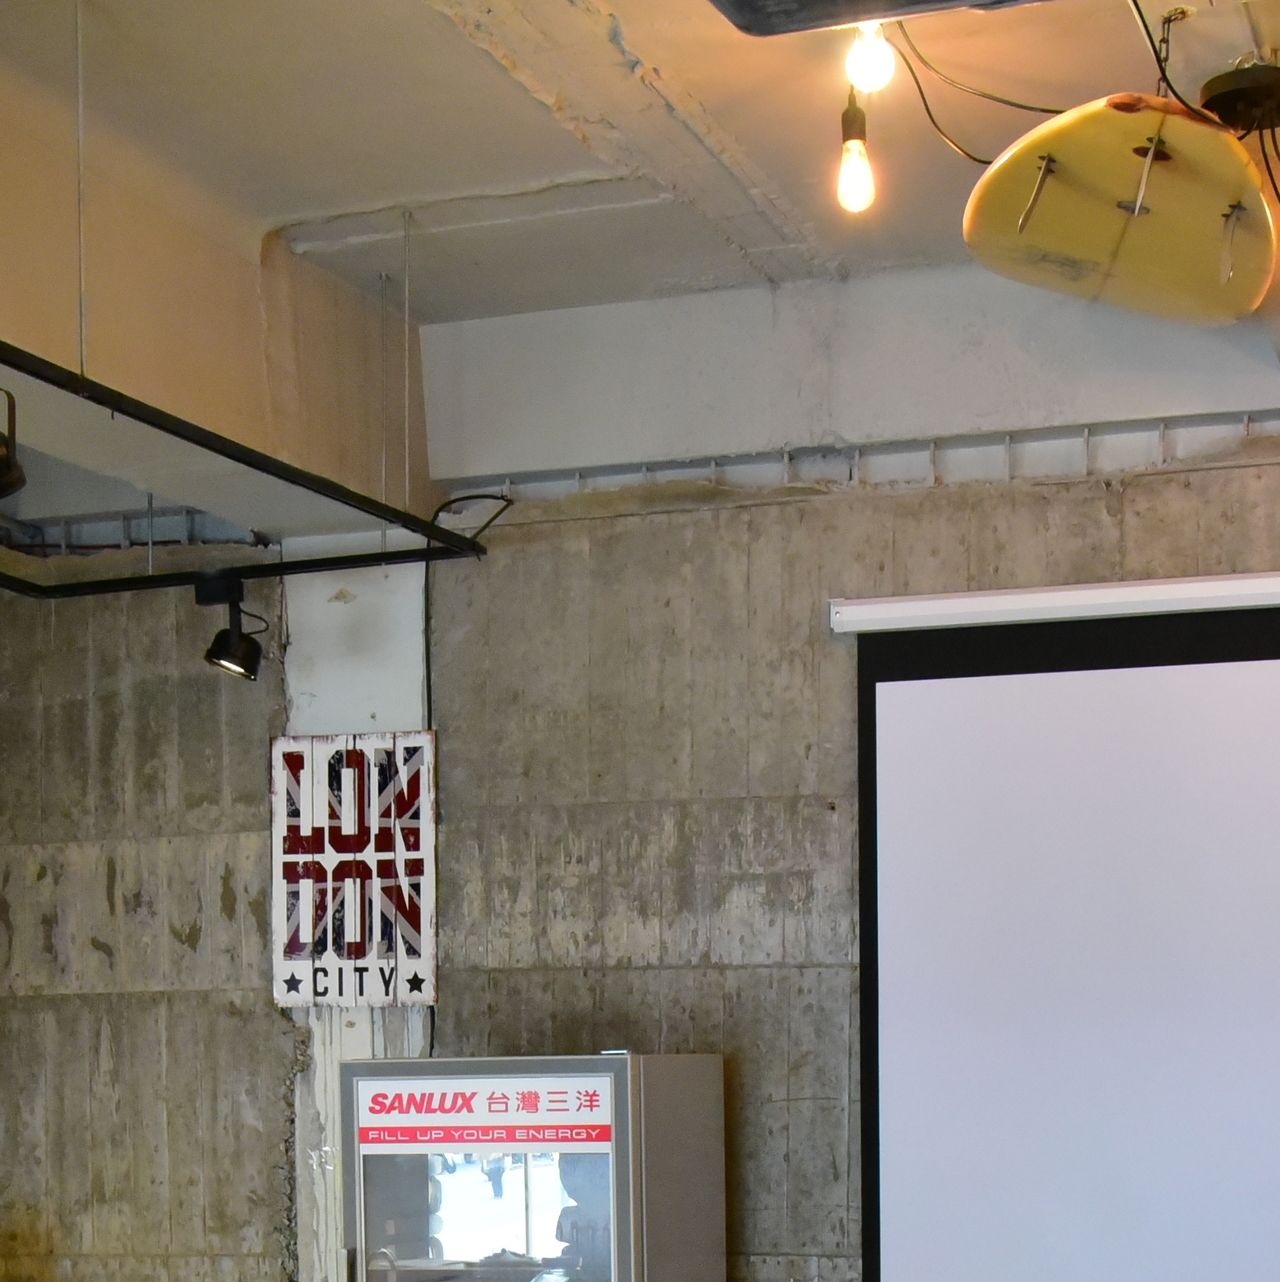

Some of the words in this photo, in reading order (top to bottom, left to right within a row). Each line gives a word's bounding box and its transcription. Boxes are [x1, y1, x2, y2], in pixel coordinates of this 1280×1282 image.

[282, 746, 425, 855] LON
[282, 857, 425, 961] DON
[313, 966, 396, 997] CITY
[368, 1091, 477, 1115] SANLUX
[486, 1089, 601, 1114] 台灣三洋
[368, 1130, 410, 1141] FILL
[417, 1130, 444, 1140] UP
[447, 1129, 507, 1140] YOUR
[515, 1128, 601, 1140] ENERGY
